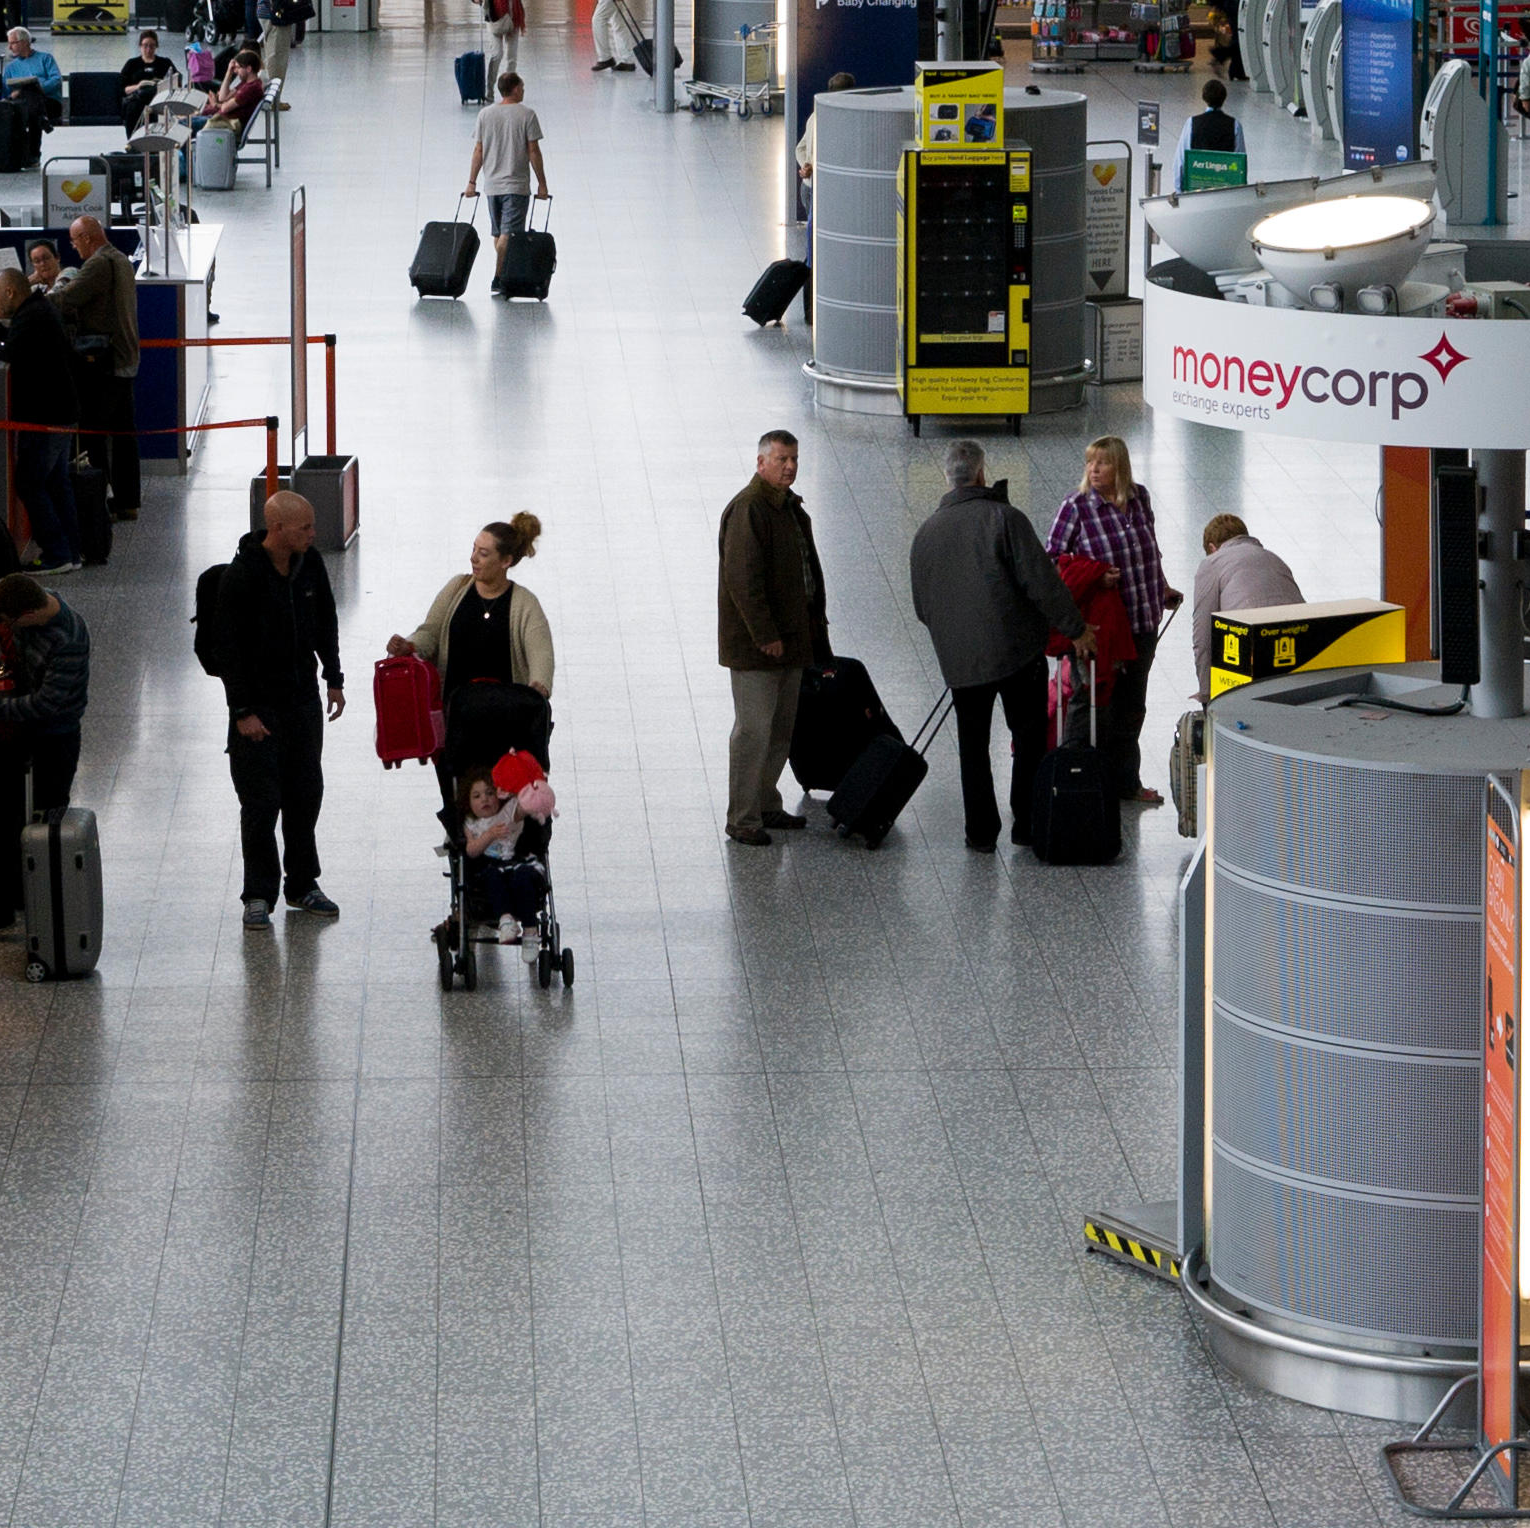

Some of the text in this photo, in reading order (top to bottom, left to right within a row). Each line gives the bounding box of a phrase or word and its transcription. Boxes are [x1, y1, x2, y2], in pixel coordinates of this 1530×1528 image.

[1205, 161, 1228, 172] Lingus
[1108, 186, 1125, 194] Cook
[1093, 194, 1116, 203] Airlines
[51, 204, 104, 212] Thomas Cook
[1091, 258, 1111, 268] HERE
[1173, 345, 1429, 420] moneycorp
[1172, 389, 1270, 420] exchange experts
[1214, 620, 1228, 630] Over
[1261, 624, 1309, 637] Over weight?
